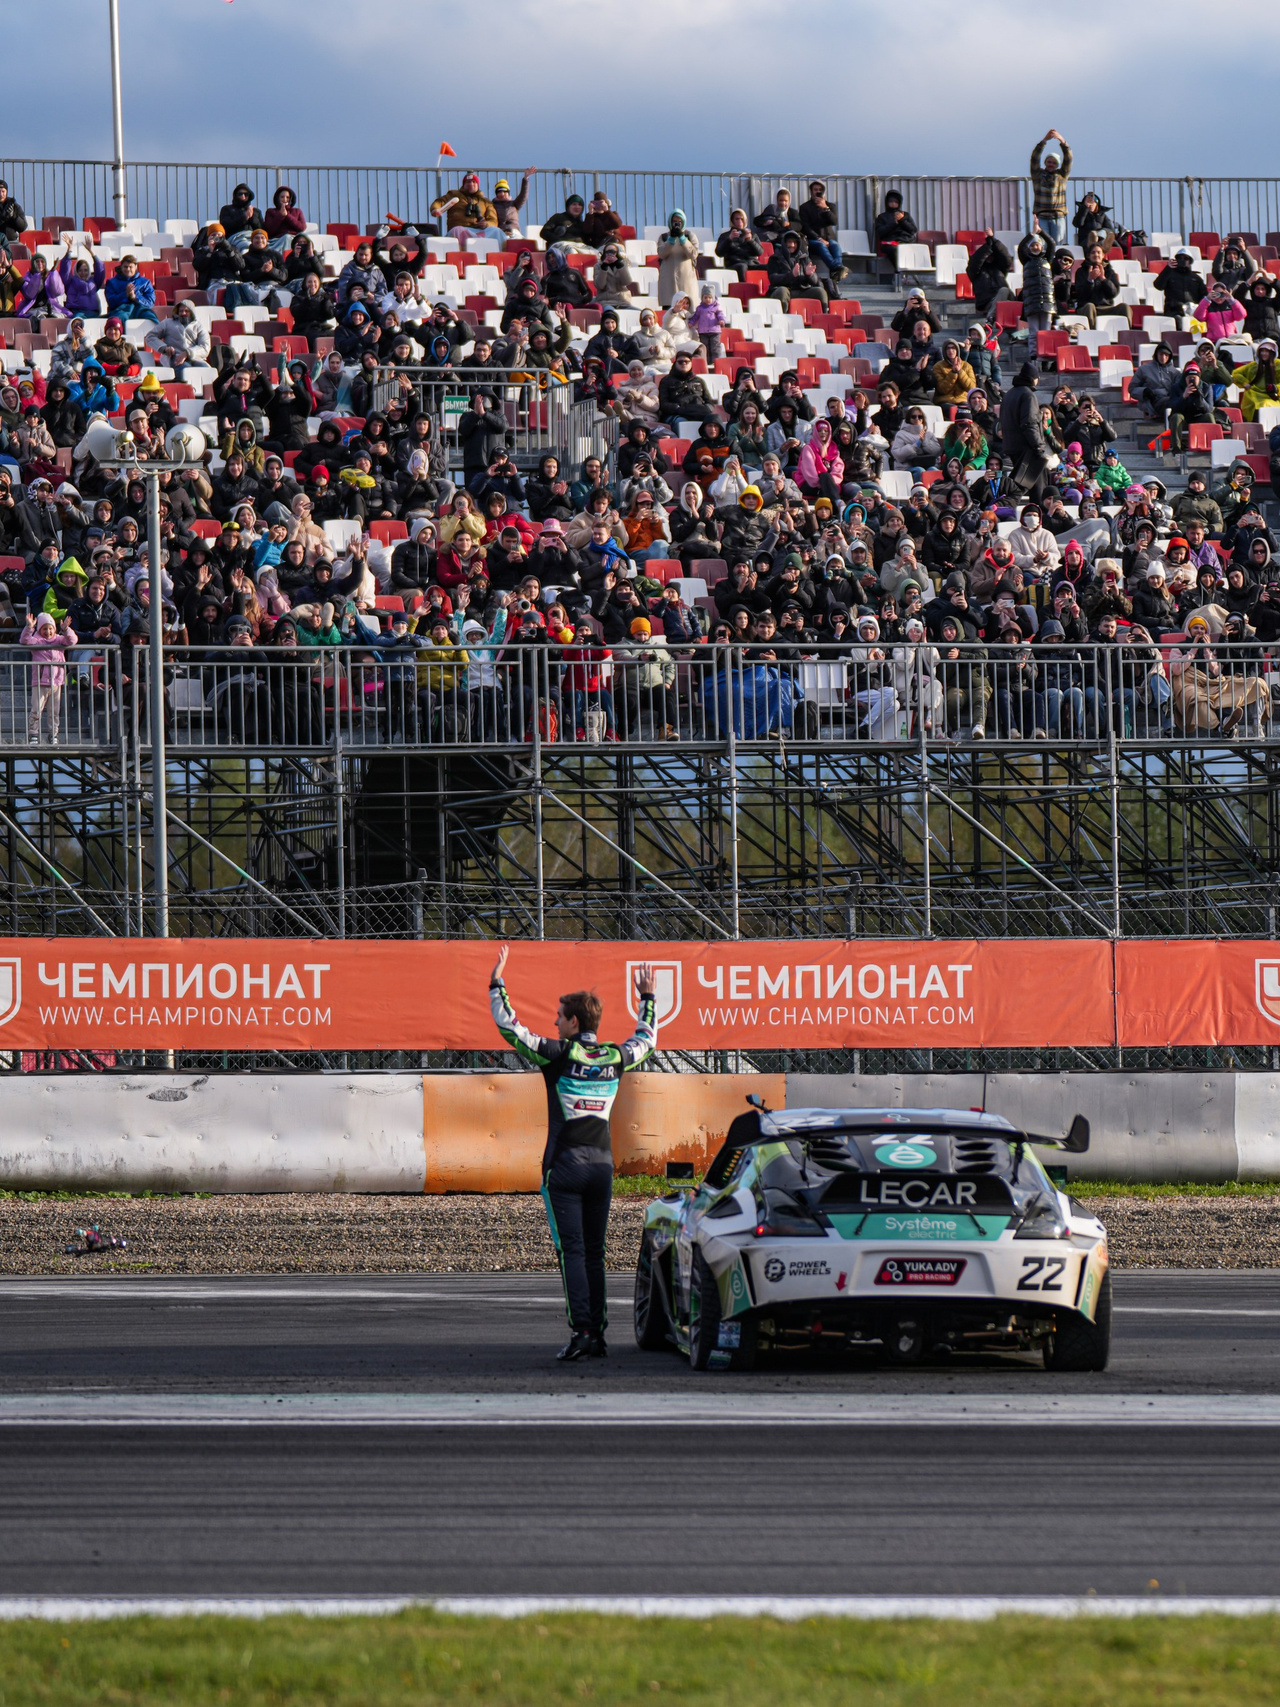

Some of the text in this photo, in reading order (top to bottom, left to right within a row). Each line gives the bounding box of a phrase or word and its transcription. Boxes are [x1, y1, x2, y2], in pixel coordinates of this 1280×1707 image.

[445, 401, 469, 411] ВЫХОД
[38, 962, 331, 999] ЧЕМПИОНАТ
[697, 964, 973, 999] ЧЕМПИОНАТ
[38, 1006, 332, 1026] WWW.CHAMPIONAT.COM
[698, 1006, 975, 1026] WWW.CHAMPIONAT.COM
[860, 1180, 977, 1208] LECAR
[885, 1216, 957, 1232] Système
[909, 1227, 957, 1239] electric
[788, 1267, 831, 1277] WHEELS
[789, 1260, 827, 1269] POWER
[904, 1262, 958, 1272] YUKA ADV
[909, 1273, 952, 1281] PRO RACING
[1016, 1256, 1067, 1290] 22
